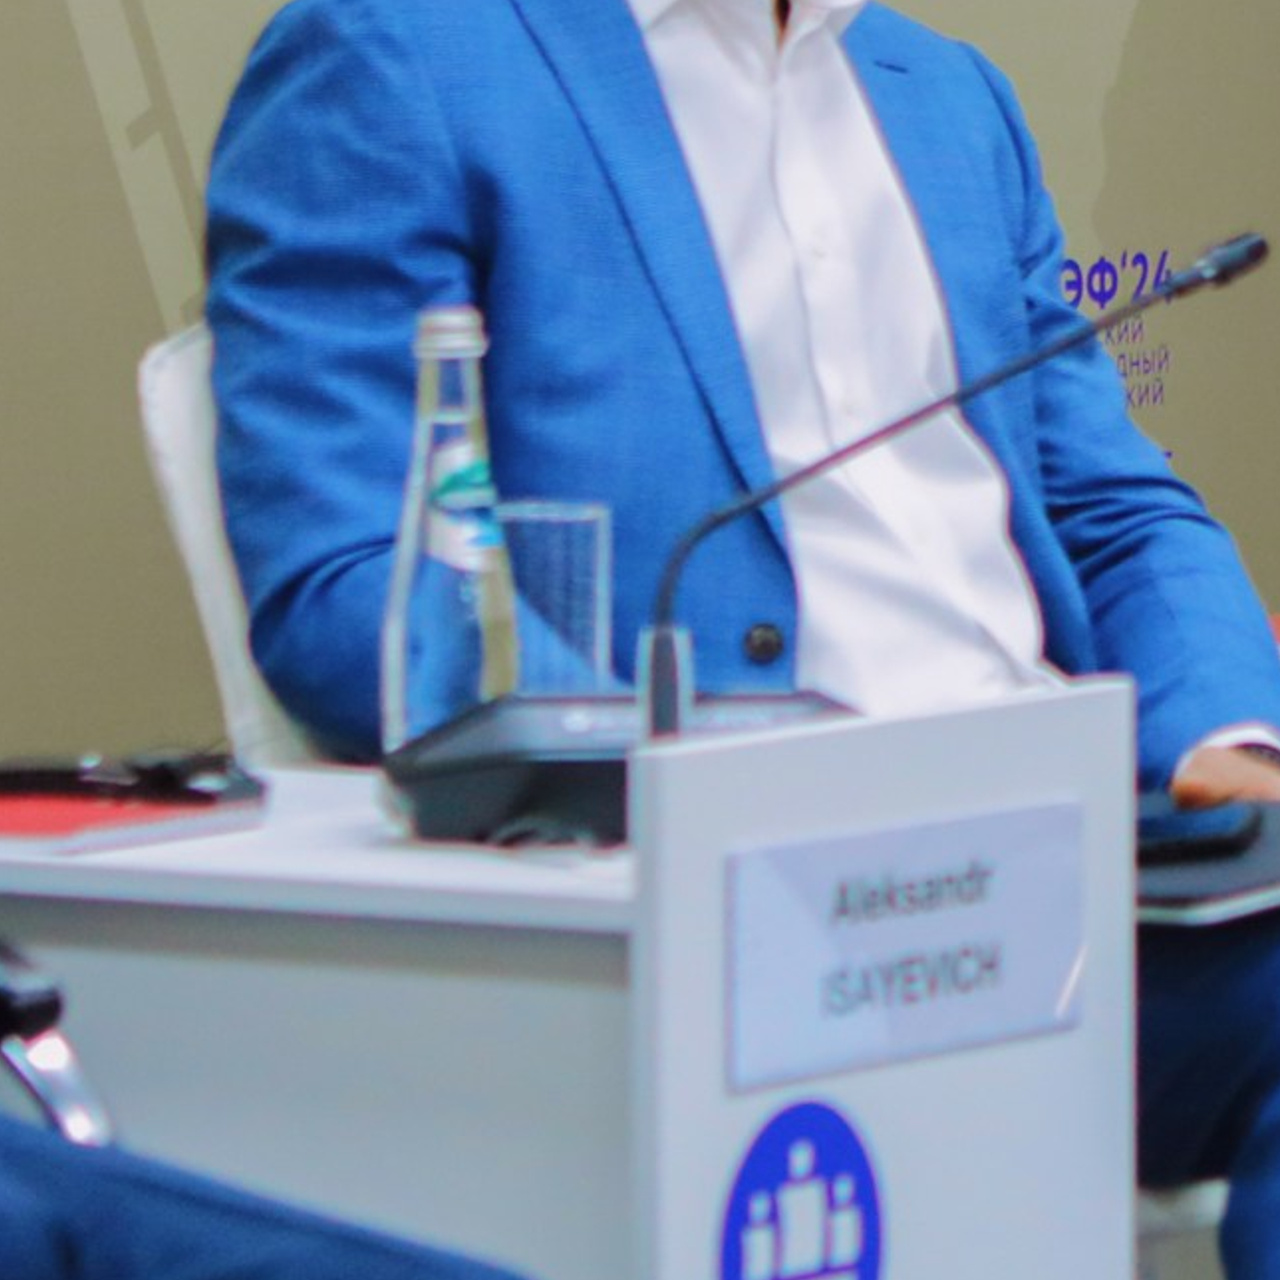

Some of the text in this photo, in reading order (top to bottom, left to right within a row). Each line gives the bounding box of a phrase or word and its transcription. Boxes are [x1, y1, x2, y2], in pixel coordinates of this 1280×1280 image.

[1061, 249, 1172, 311] ЭФ'24
[1103, 314, 1144, 346] КИЙ
[1116, 344, 1170, 378] ДНЫЙ
[1126, 376, 1164, 408] КИЙ
[830, 861, 994, 926] Aleksandr
